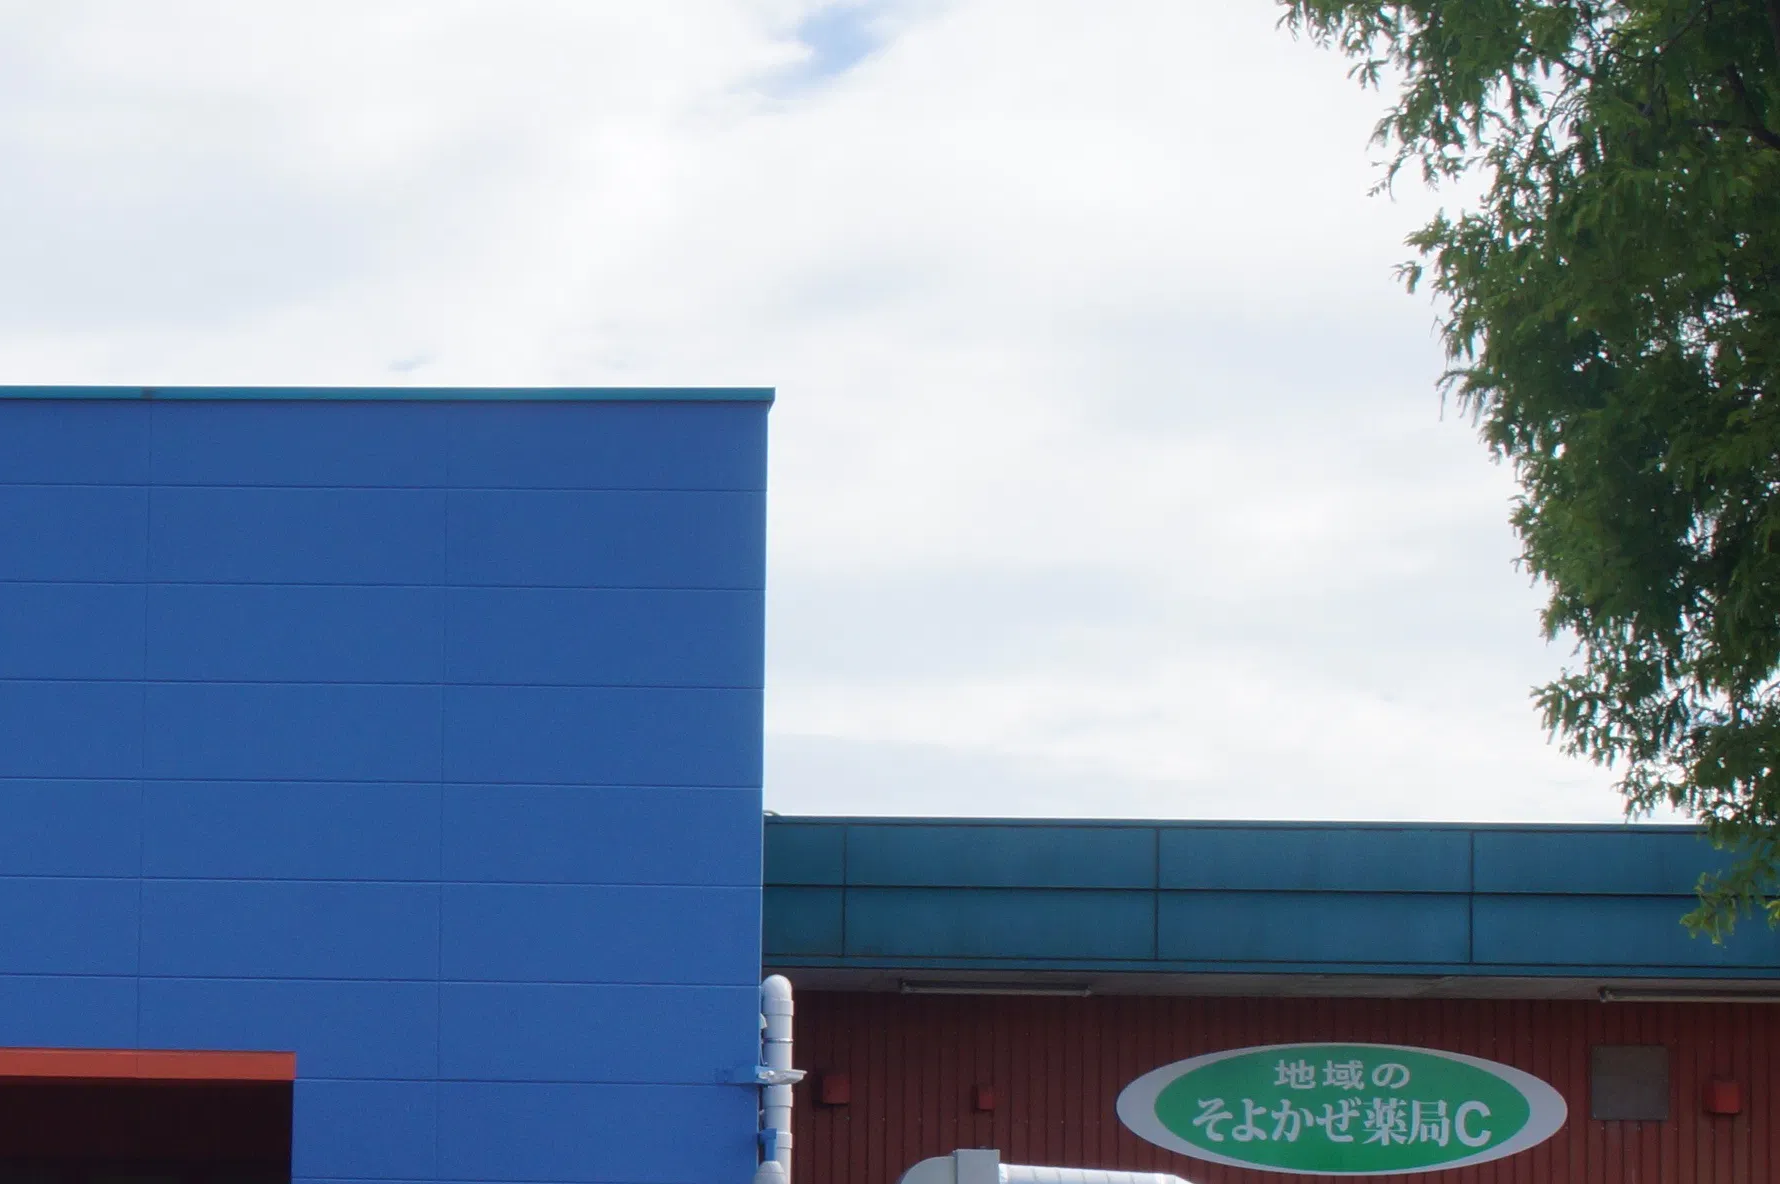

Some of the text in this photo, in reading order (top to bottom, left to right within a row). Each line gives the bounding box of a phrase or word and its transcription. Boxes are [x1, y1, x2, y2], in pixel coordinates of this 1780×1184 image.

[1274, 1060, 1411, 1090] 地域の
[1192, 1097, 1492, 1147] そよかぜ薬局C
